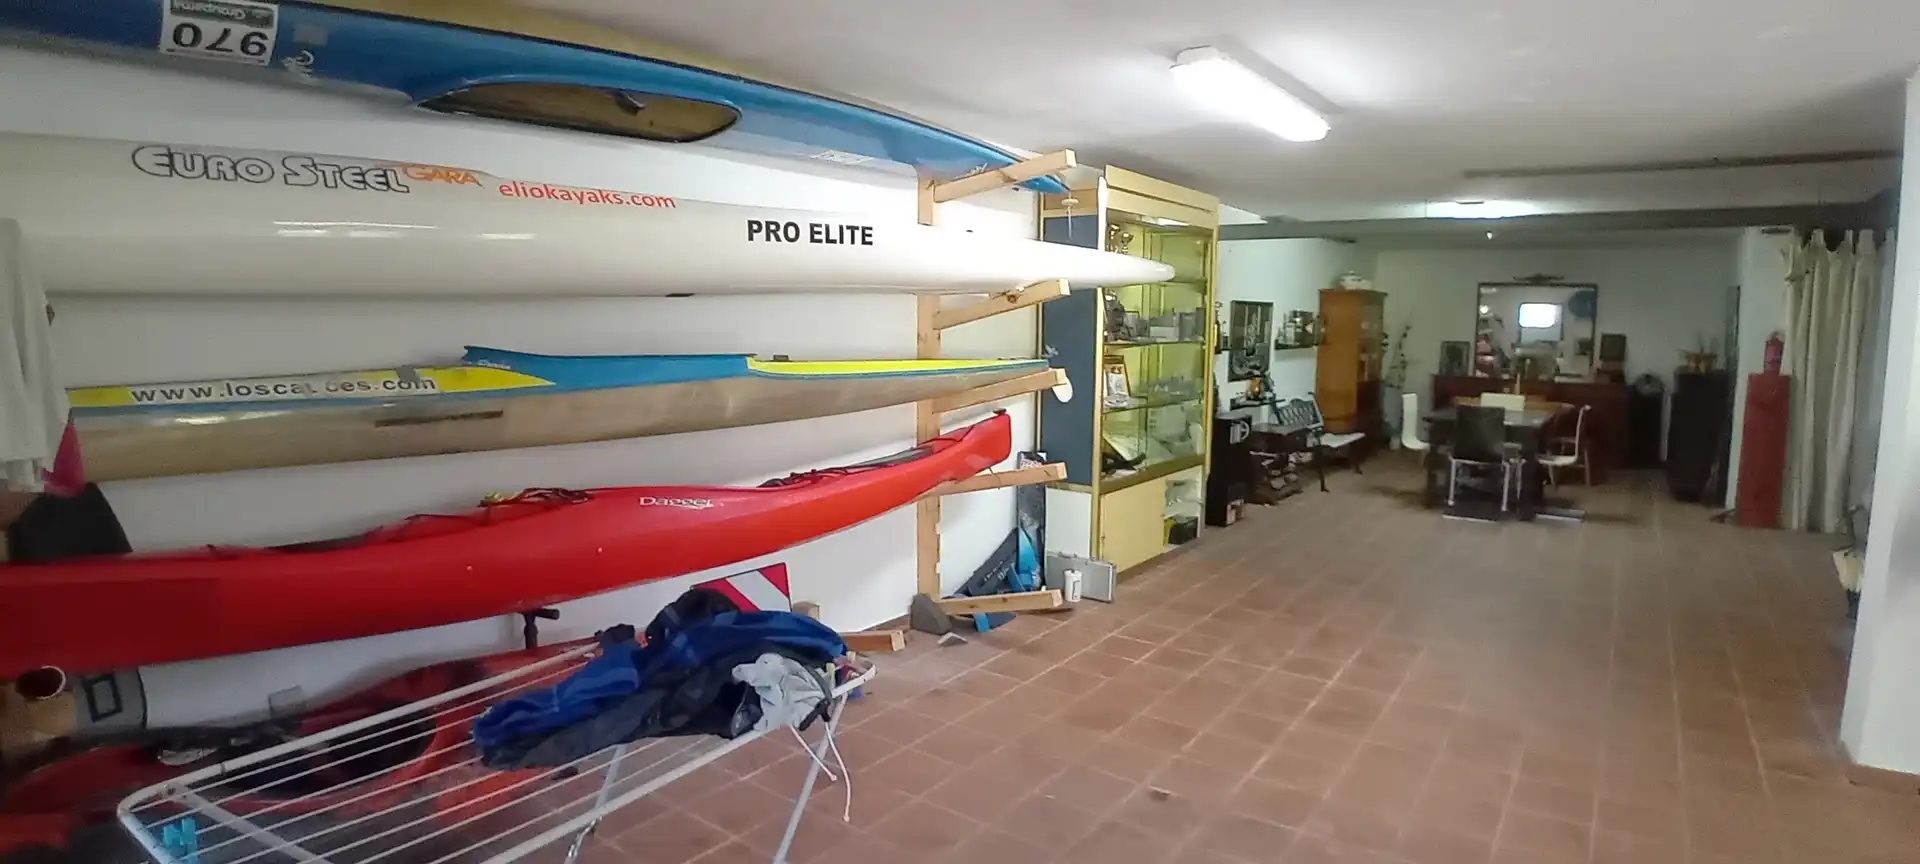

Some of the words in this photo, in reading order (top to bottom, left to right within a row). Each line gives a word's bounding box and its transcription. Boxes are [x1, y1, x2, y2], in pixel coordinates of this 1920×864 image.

[172, 22, 269, 56] 970
[132, 145, 275, 183] EURO
[281, 156, 410, 193] STEEL
[499, 181, 676, 208] eliokayaks.com
[747, 219, 800, 243] PRO
[809, 222, 873, 246] ELITE
